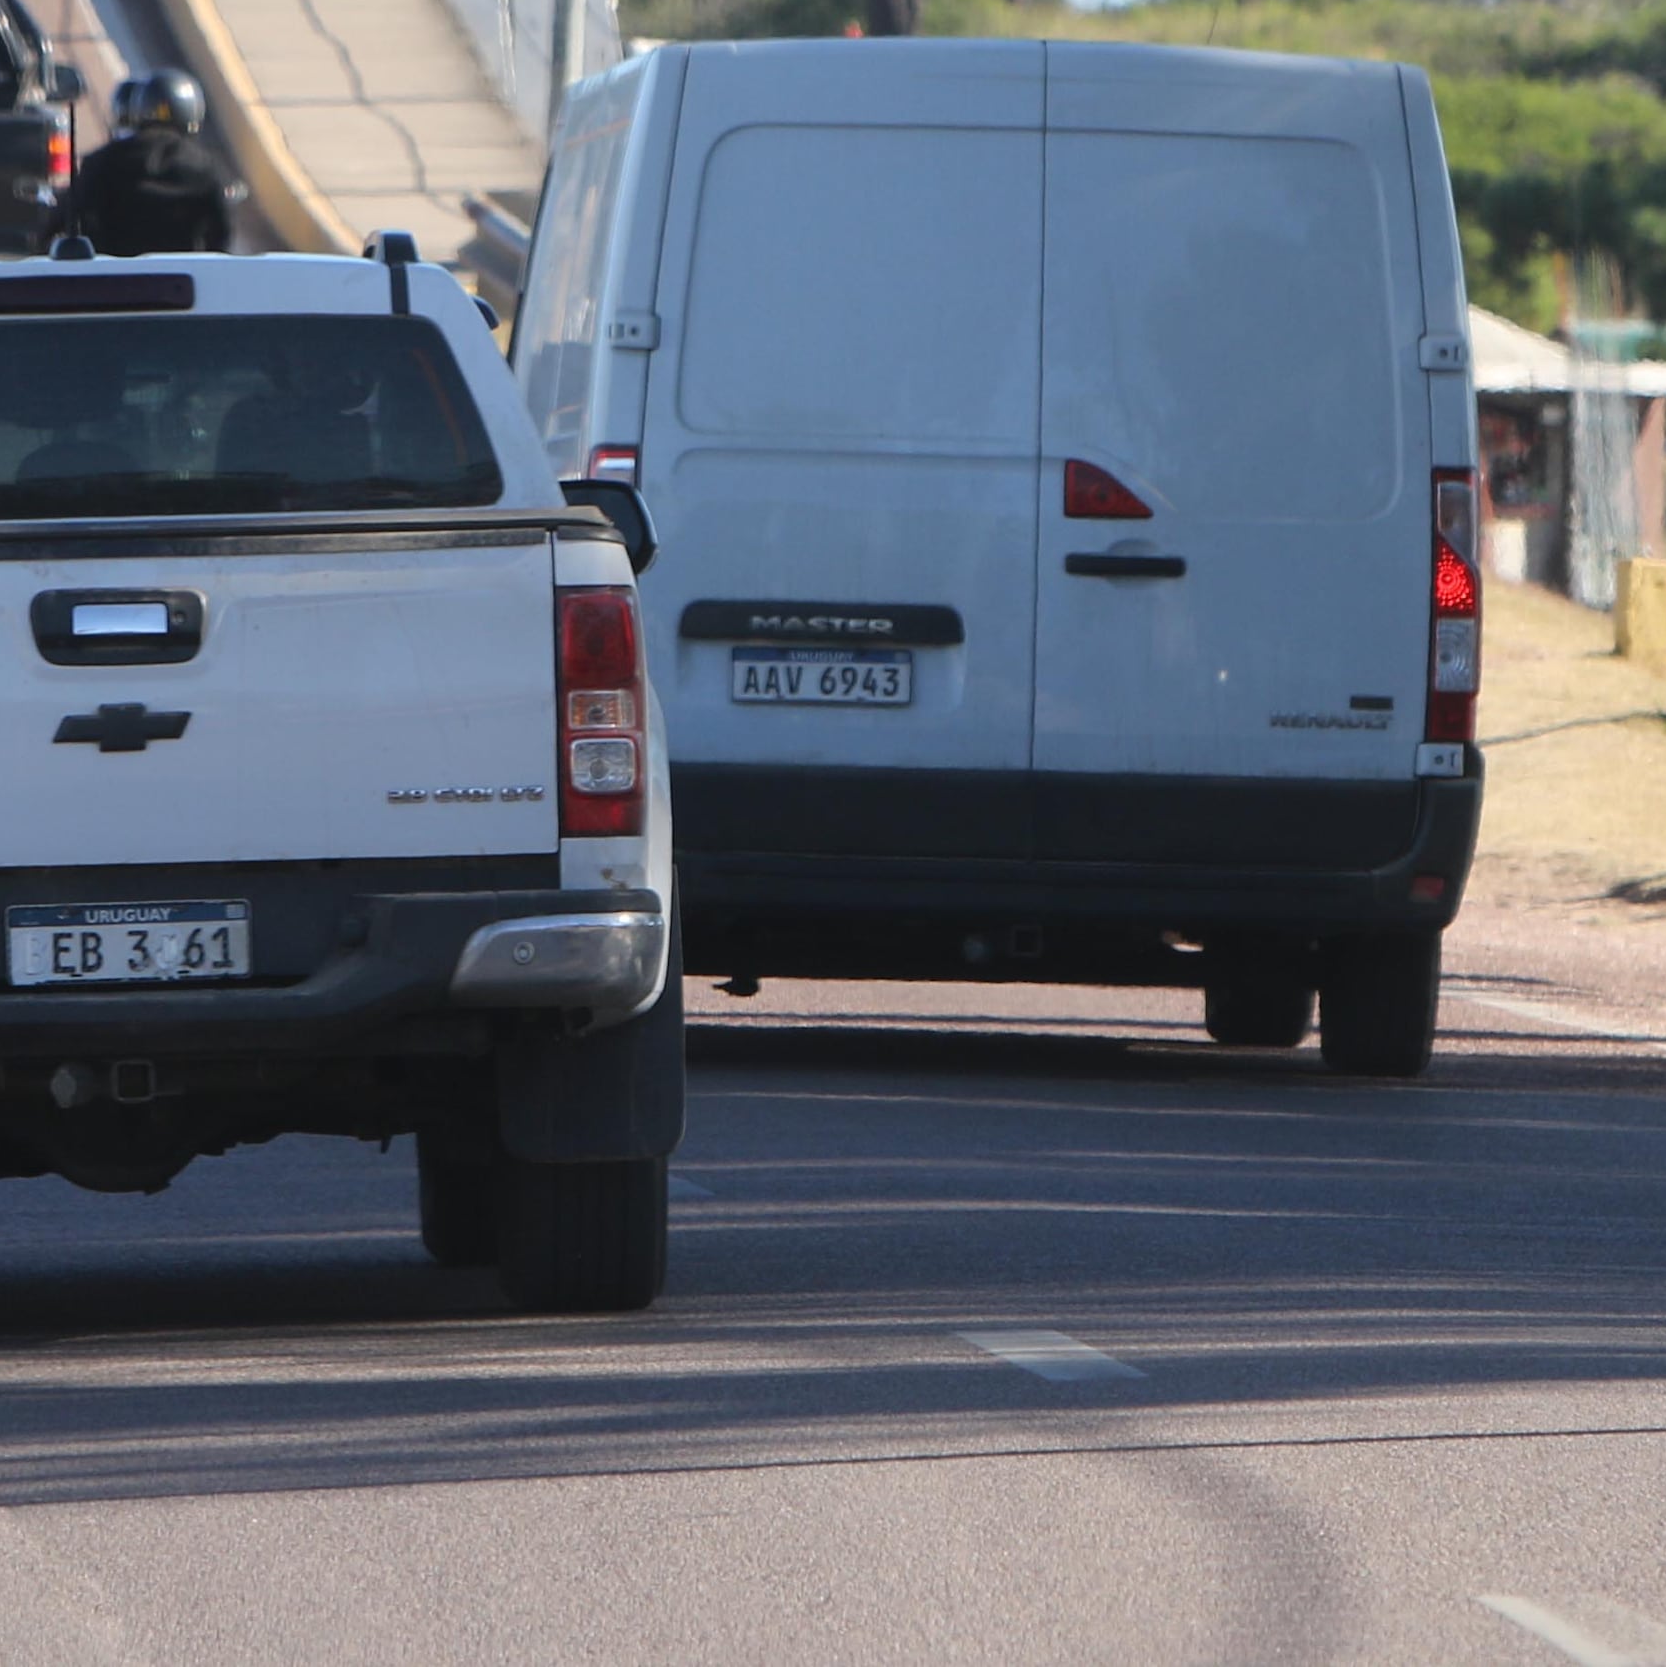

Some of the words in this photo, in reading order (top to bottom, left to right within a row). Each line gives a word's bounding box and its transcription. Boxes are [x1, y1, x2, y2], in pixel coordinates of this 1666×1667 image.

[749, 615, 894, 633] MASTER
[743, 665, 803, 695] AAV
[820, 666, 900, 697] 6943
[84, 907, 172, 924] URUGUAY
